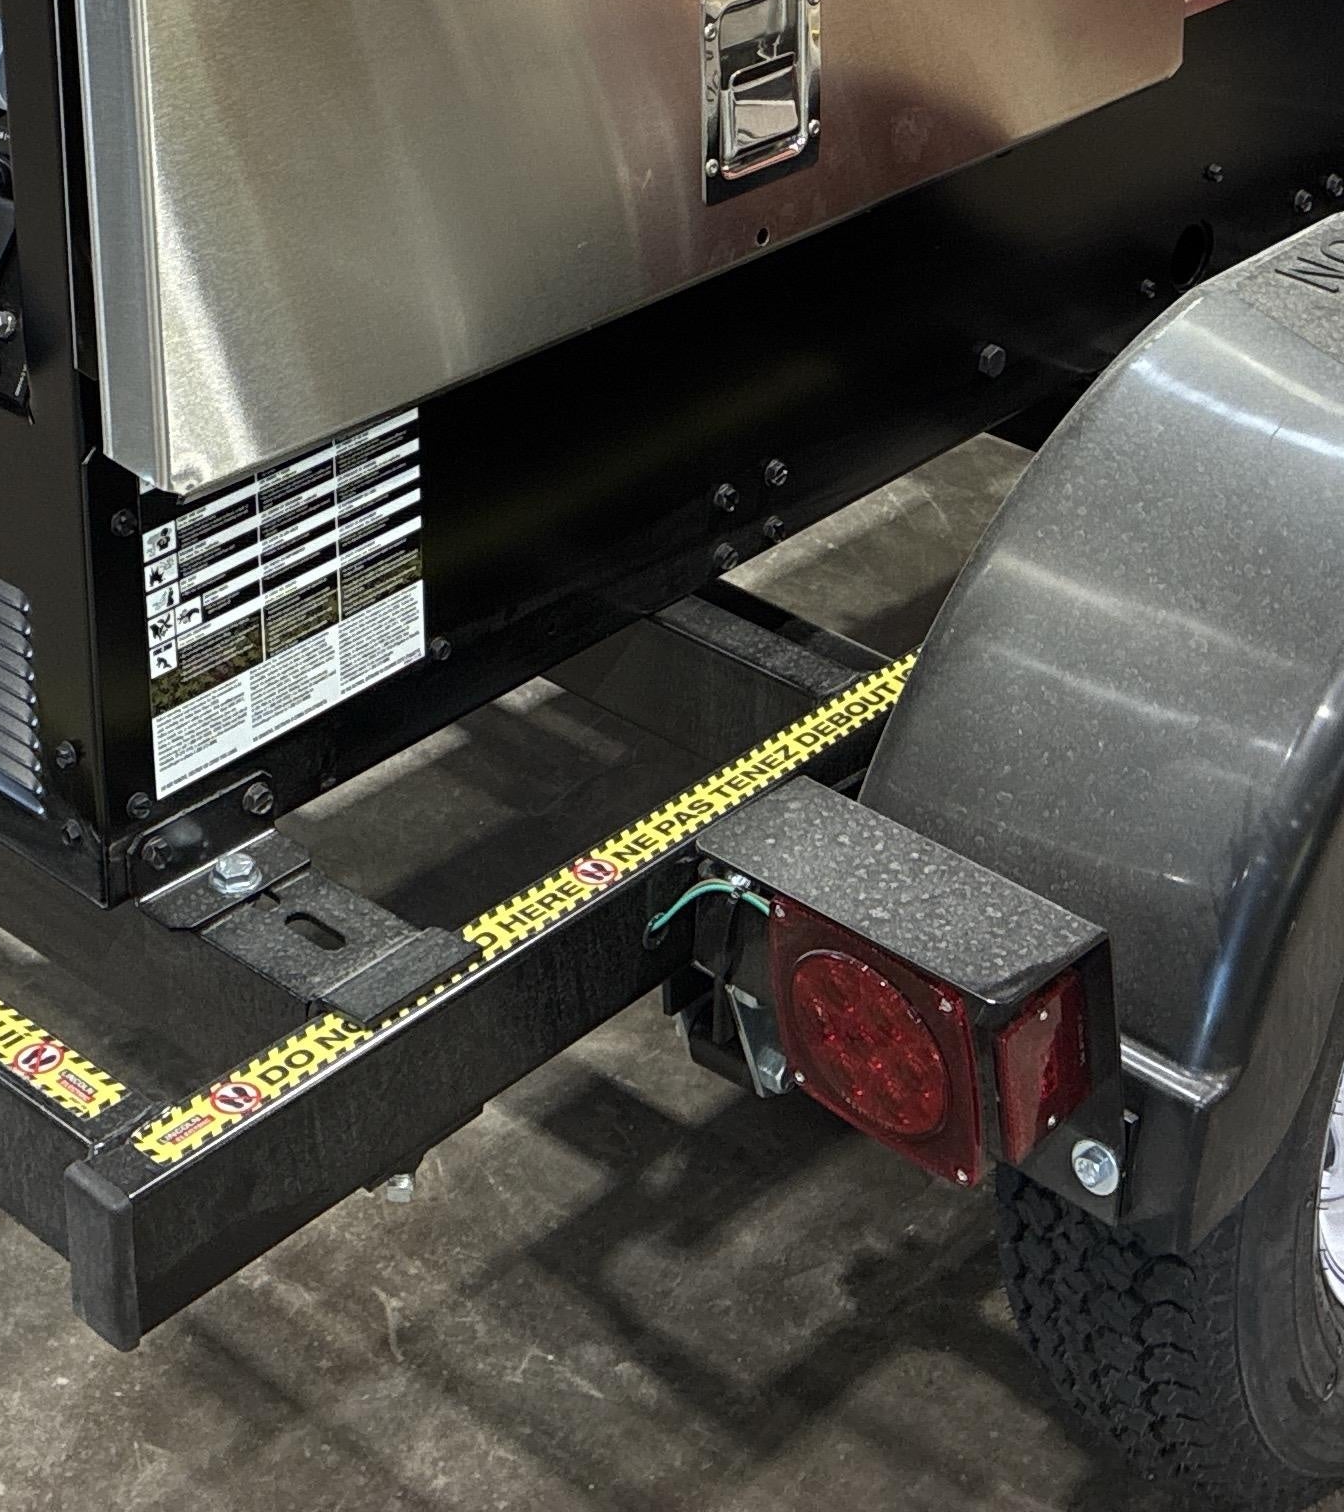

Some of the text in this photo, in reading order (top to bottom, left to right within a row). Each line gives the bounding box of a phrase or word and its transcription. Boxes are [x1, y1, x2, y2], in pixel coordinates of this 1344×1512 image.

[612, 835, 658, 865] NE
[652, 798, 716, 837] PAS
[707, 745, 801, 803] TENEZ
[792, 681, 898, 748] DEBOUT
[499, 881, 584, 934] HERE
[60, 1070, 97, 1095] LINCOLN
[256, 1049, 315, 1086] DO
[158, 1115, 203, 1145] LINCOLN
[172, 1116, 215, 1145] ELECTRIC
